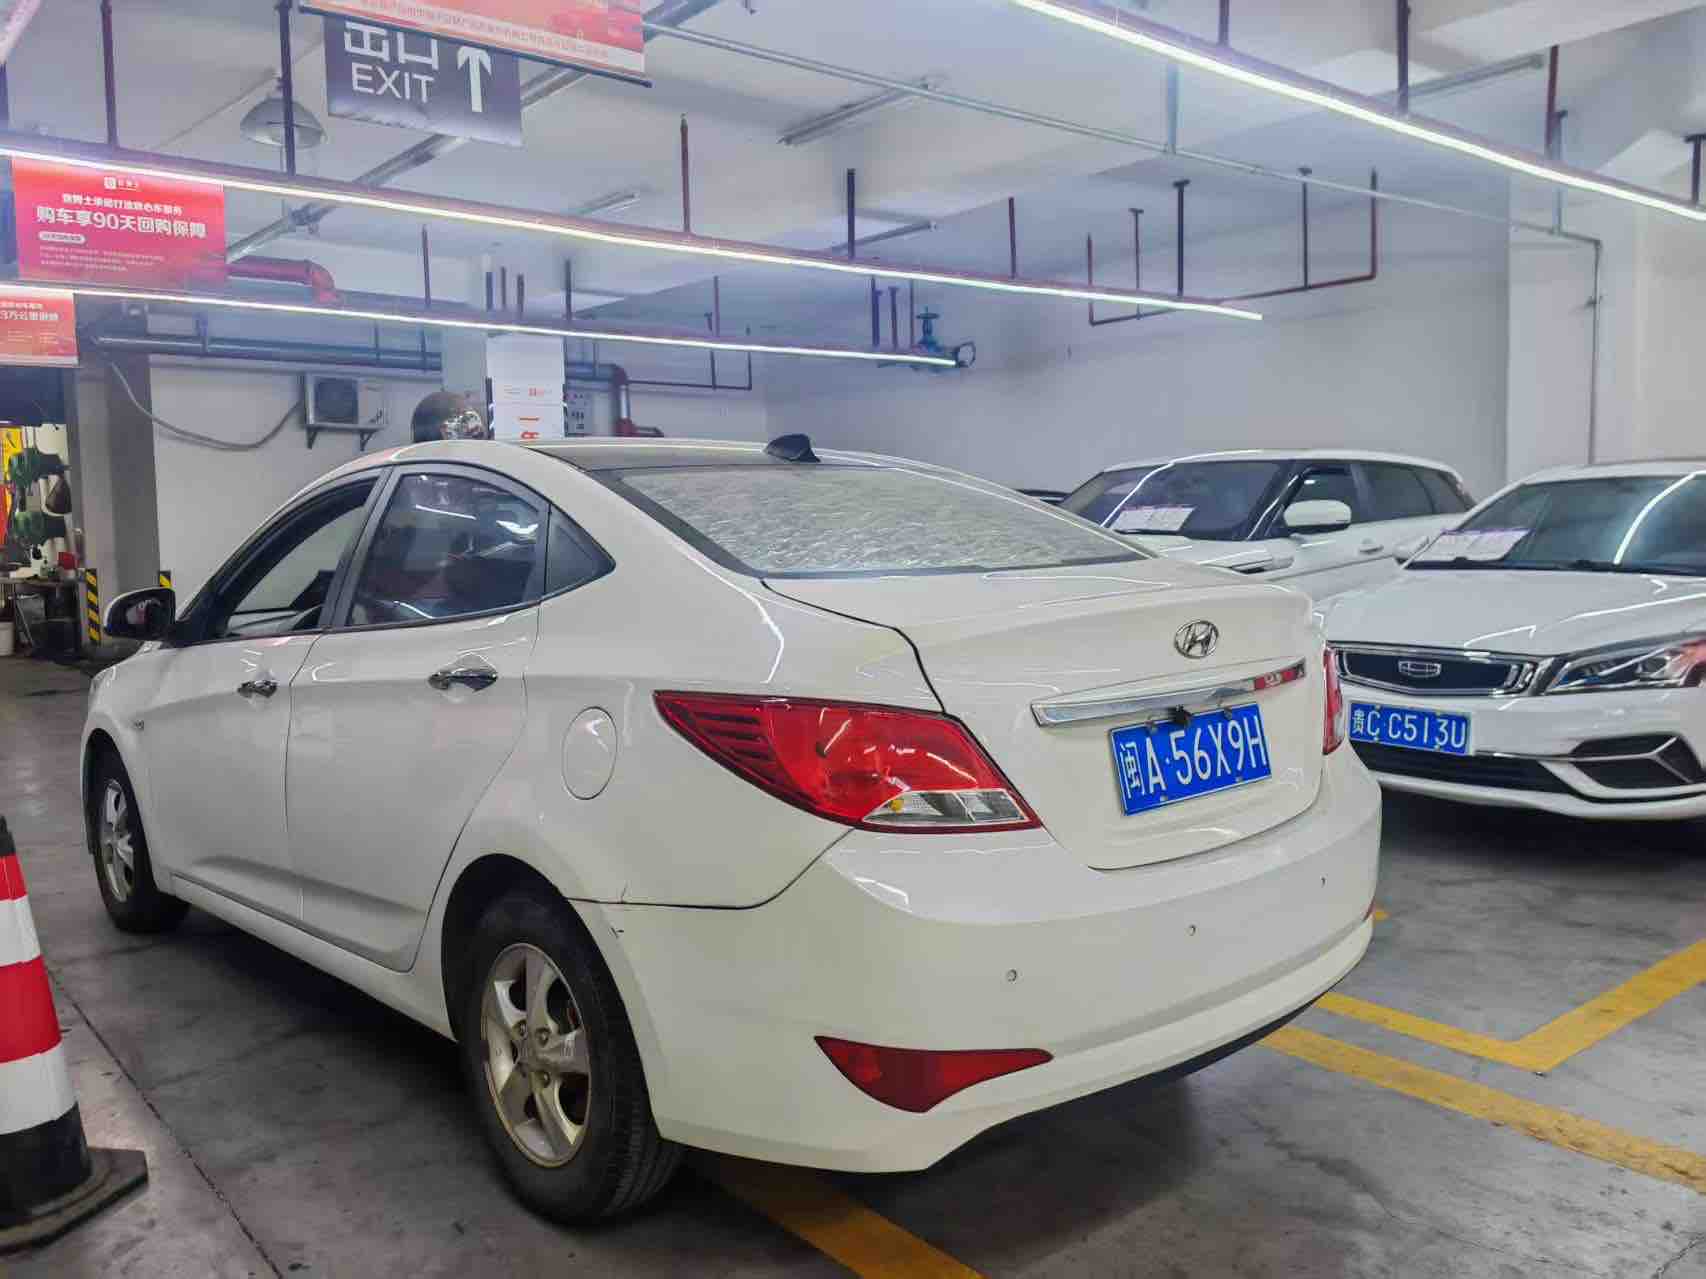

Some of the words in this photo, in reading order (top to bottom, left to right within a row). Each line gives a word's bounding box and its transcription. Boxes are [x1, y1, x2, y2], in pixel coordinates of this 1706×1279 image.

[352, 62, 435, 103] EXIT
[36, 206, 206, 238] 购车享90天回购保障
